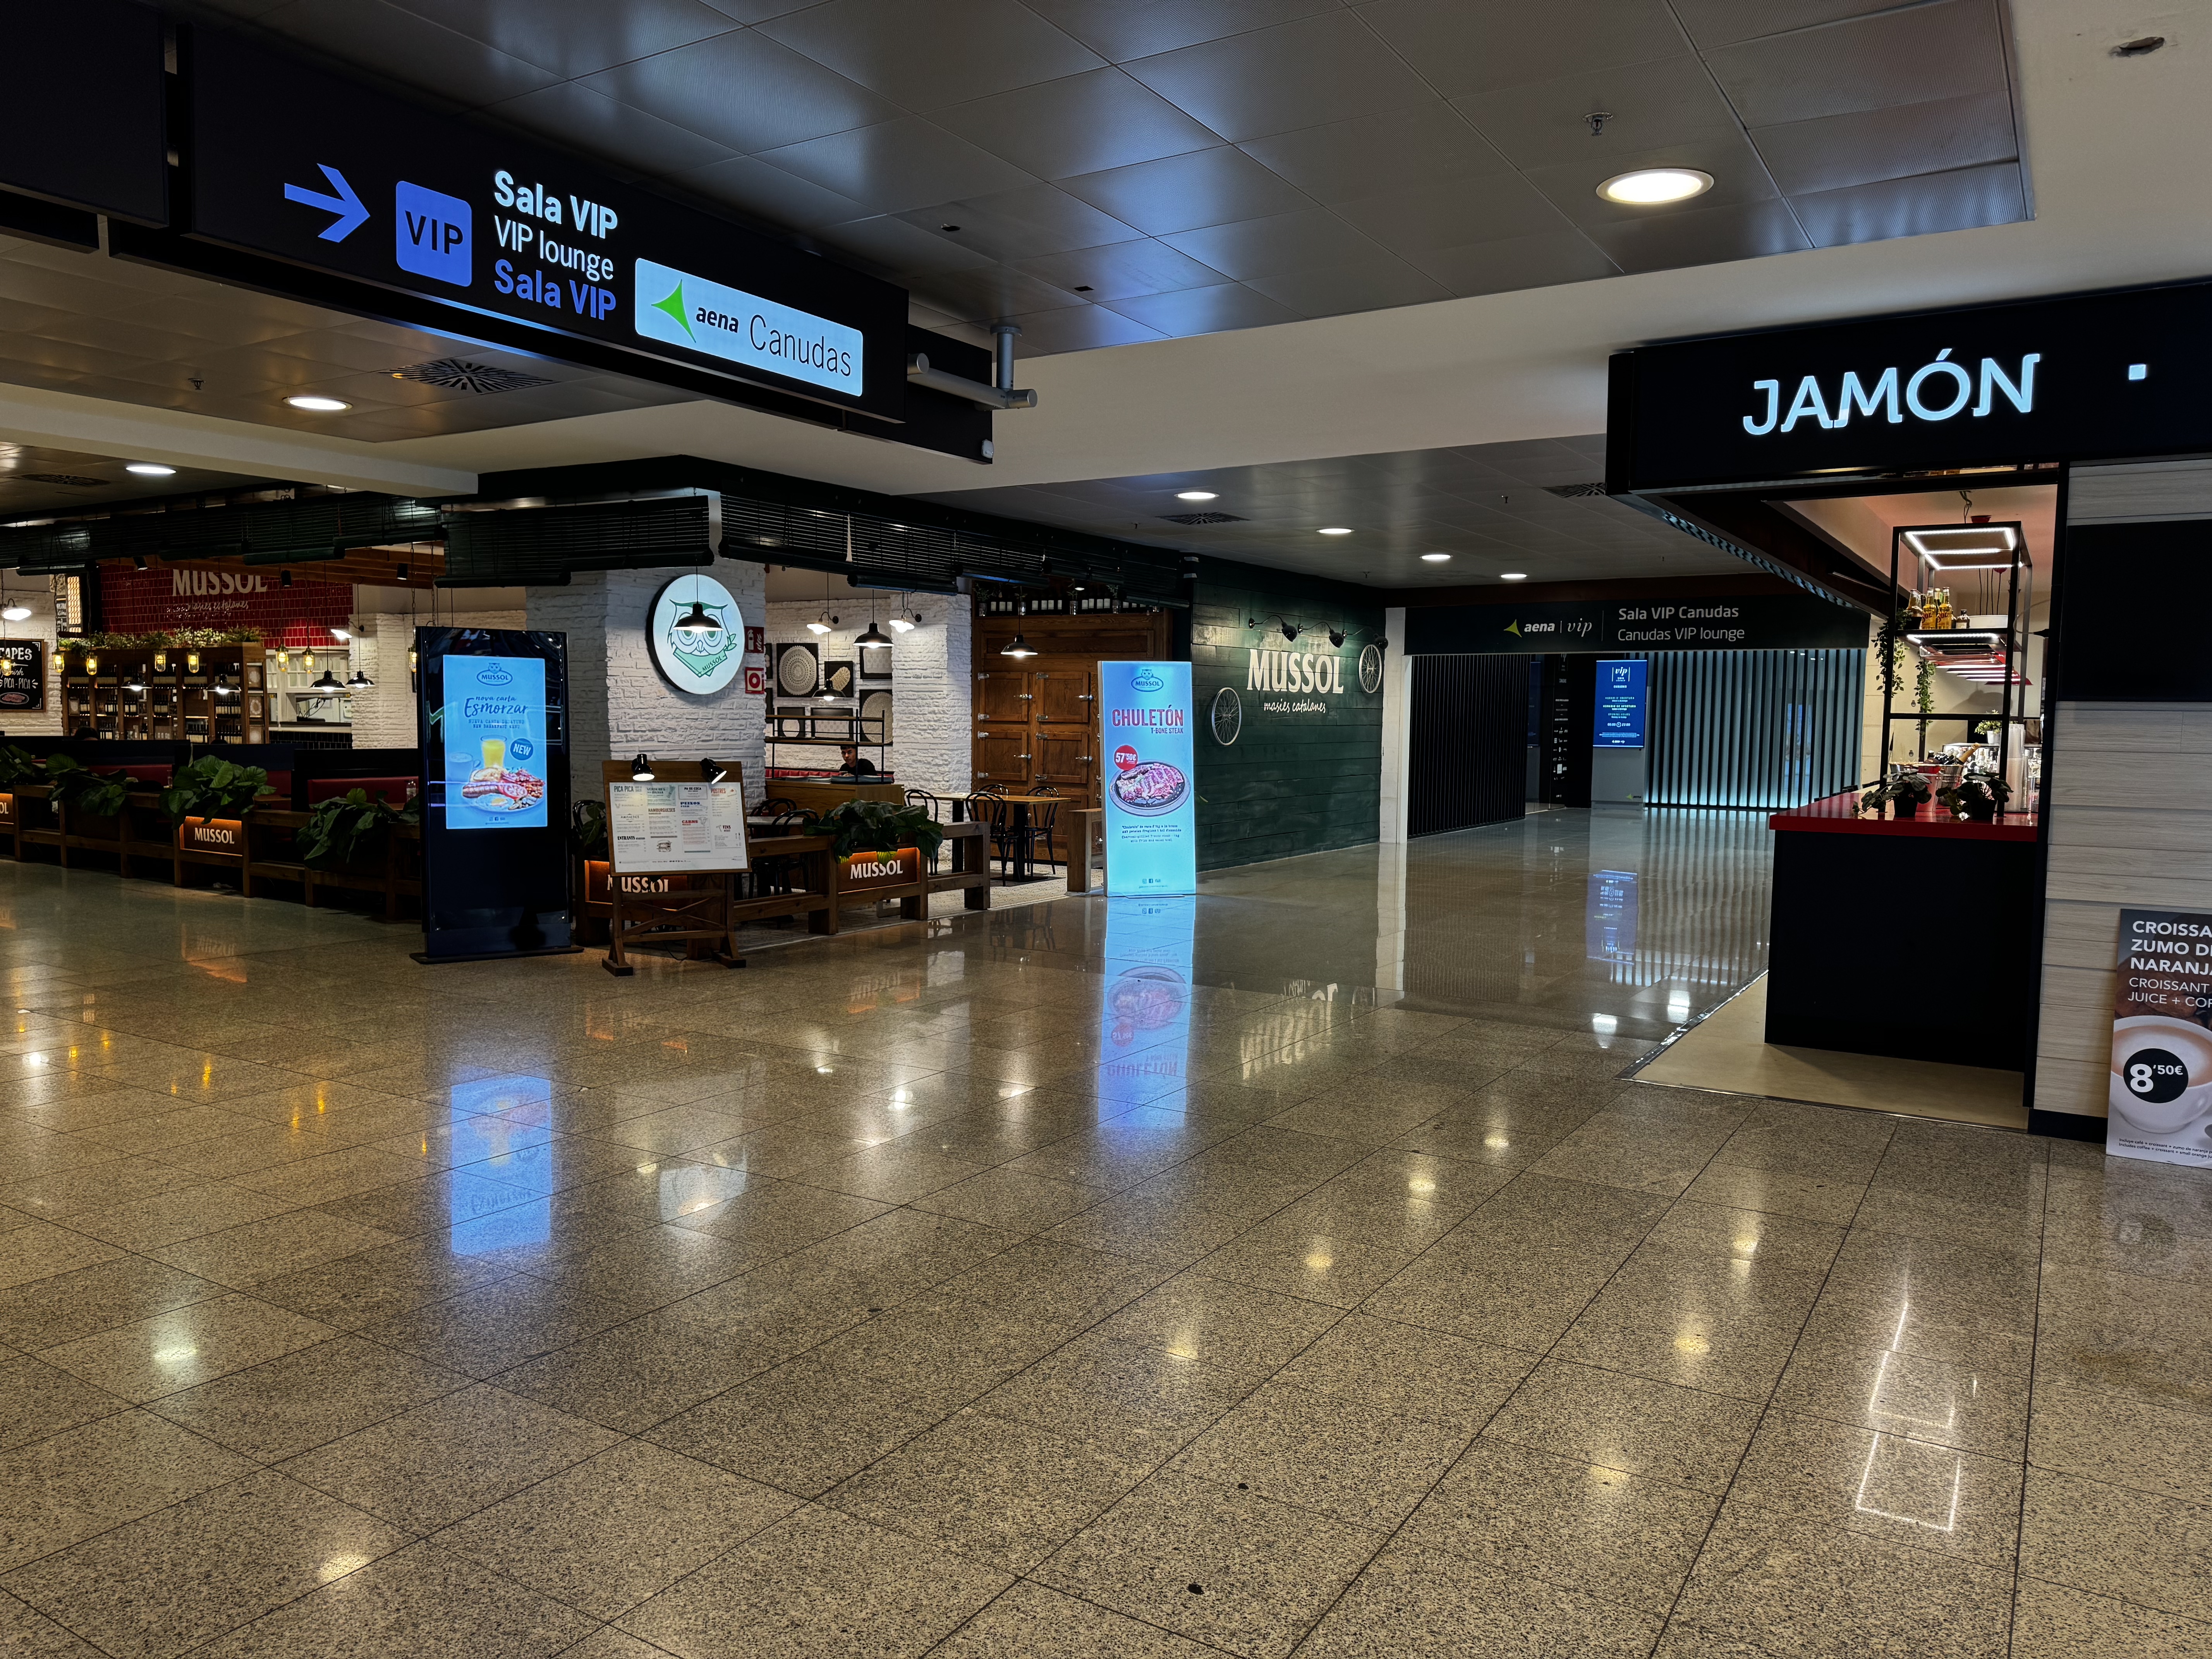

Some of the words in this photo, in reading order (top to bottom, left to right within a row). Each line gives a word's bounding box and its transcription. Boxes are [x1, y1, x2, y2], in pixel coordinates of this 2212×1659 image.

[494, 170, 562, 225] Sala
[570, 195, 618, 239] VIP
[405, 210, 464, 254] VIP
[494, 215, 533, 252] VIP
[540, 230, 614, 282] lounge
[495, 259, 561, 309] Sala
[569, 280, 617, 320] VIP
[696, 307, 739, 333] aena
[750, 314, 851, 377] Canudas
[1743, 348, 2040, 436] JAMÓN
[1619, 608, 1647, 620] Sala
[1651, 607, 1675, 619] VIP
[1679, 606, 1739, 619] Canudas
[1524, 622, 1555, 632] aena
[1567, 618, 1592, 637] vip
[1618, 629, 1671, 641] Canudas
[1675, 628, 1697, 640] VIP
[1700, 627, 1745, 642] lounge
[702, 655, 723, 672] MUSSOL
[1247, 649, 1344, 694] MUSSOL
[1615, 666, 1627, 677] vip
[464, 697, 528, 718] Esmorzar
[1112, 704, 1183, 726] CHULETÓN
[1264, 699, 1290, 713] masies
[1292, 699, 1326, 713] catalanes
[513, 744, 531, 756] NEW
[195, 827, 235, 844] MUSSOL
[850, 860, 903, 879] MUSSOL
[2131, 939, 2189, 955] ZUMO
[2196, 943, 2212, 957] D
[2131, 957, 2212, 975] NARANJ
[2129, 977, 2210, 993] CROISSANT
[2128, 991, 2167, 1004] JUICE
